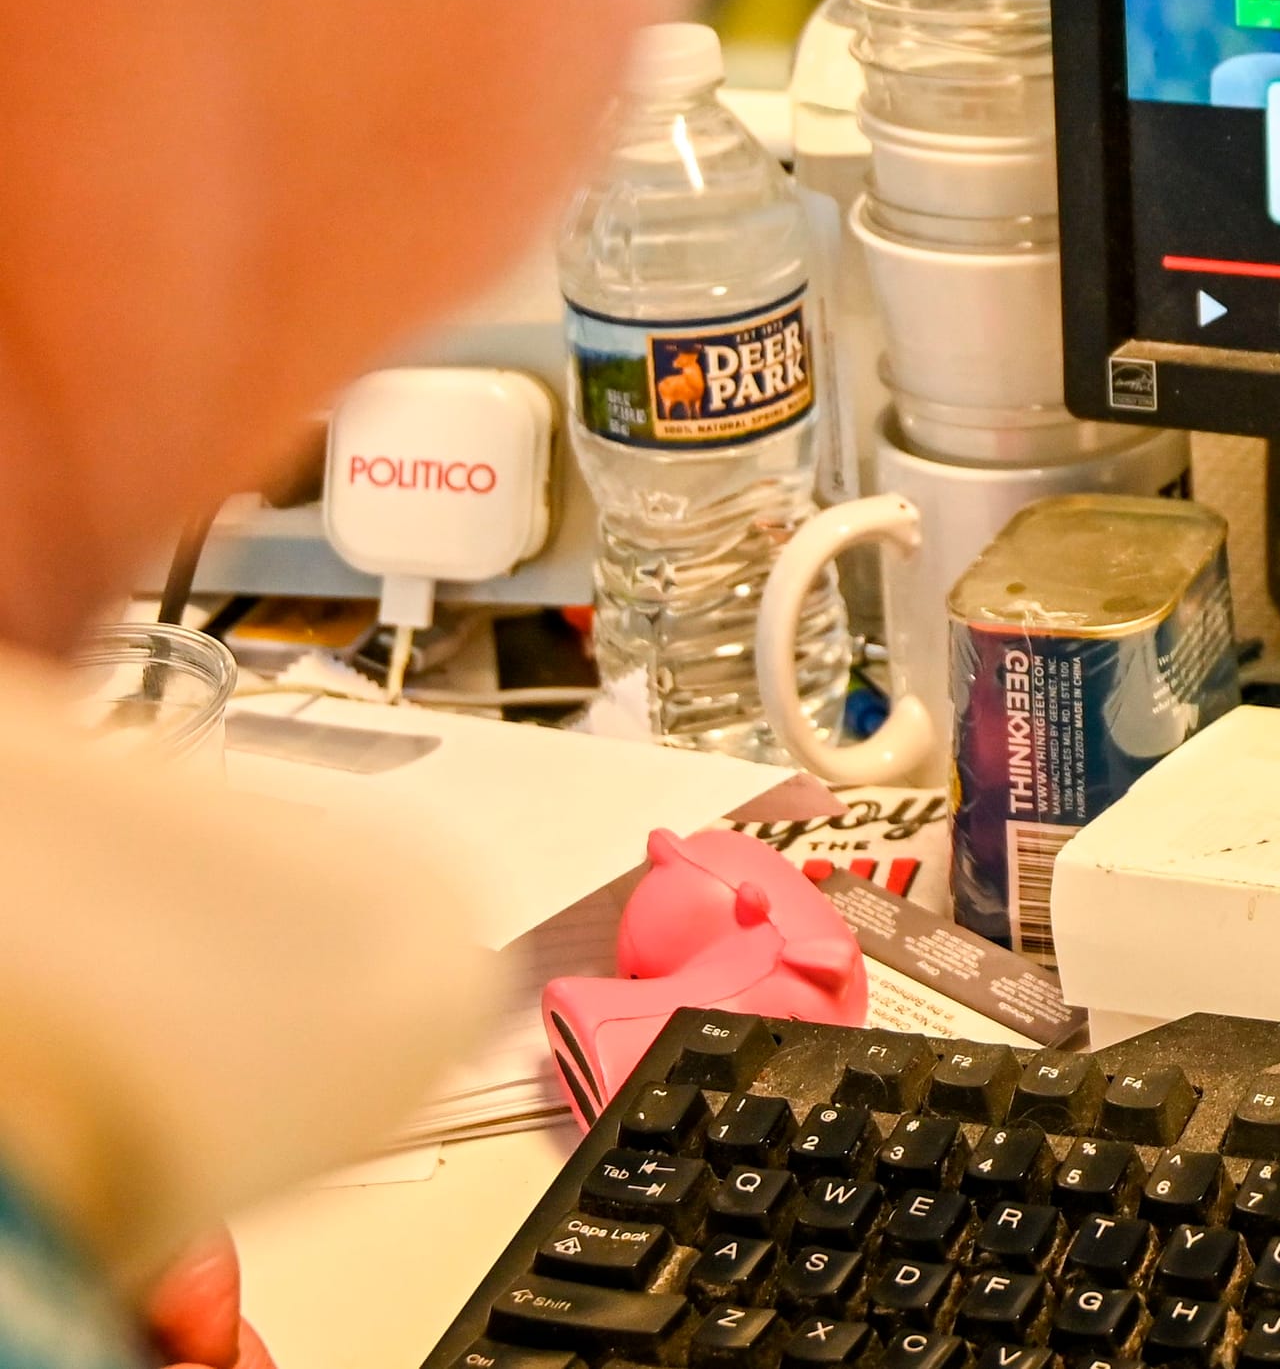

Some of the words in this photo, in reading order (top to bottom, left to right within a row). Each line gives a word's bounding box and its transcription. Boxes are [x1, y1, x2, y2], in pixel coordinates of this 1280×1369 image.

[704, 321, 804, 380] DEER
[708, 359, 805, 413] PARK
[350, 455, 497, 494] POLITICO
[1071, 656, 1082, 686] CHINA
[1073, 701, 1083, 728] MADE
[1034, 655, 1049, 812] WWW.THINKGEEK.COM
[702, 1023, 730, 1038] Esc
[868, 1045, 887, 1058] F1
[952, 1055, 972, 1068] F2
[1038, 1066, 1059, 1079] F3
[1122, 1077, 1142, 1089] F4
[1253, 1094, 1275, 1108] F5
[602, 1163, 629, 1181] Tab
[735, 1172, 762, 1193] Q
[824, 1182, 858, 1204] W
[909, 1196, 935, 1217] E
[998, 1208, 1024, 1229] R
[567, 1220, 608, 1240] Caps
[611, 1227, 650, 1242] Lock
[715, 1241, 738, 1261] A
[805, 1253, 829, 1272] S
[895, 1265, 921, 1285] D
